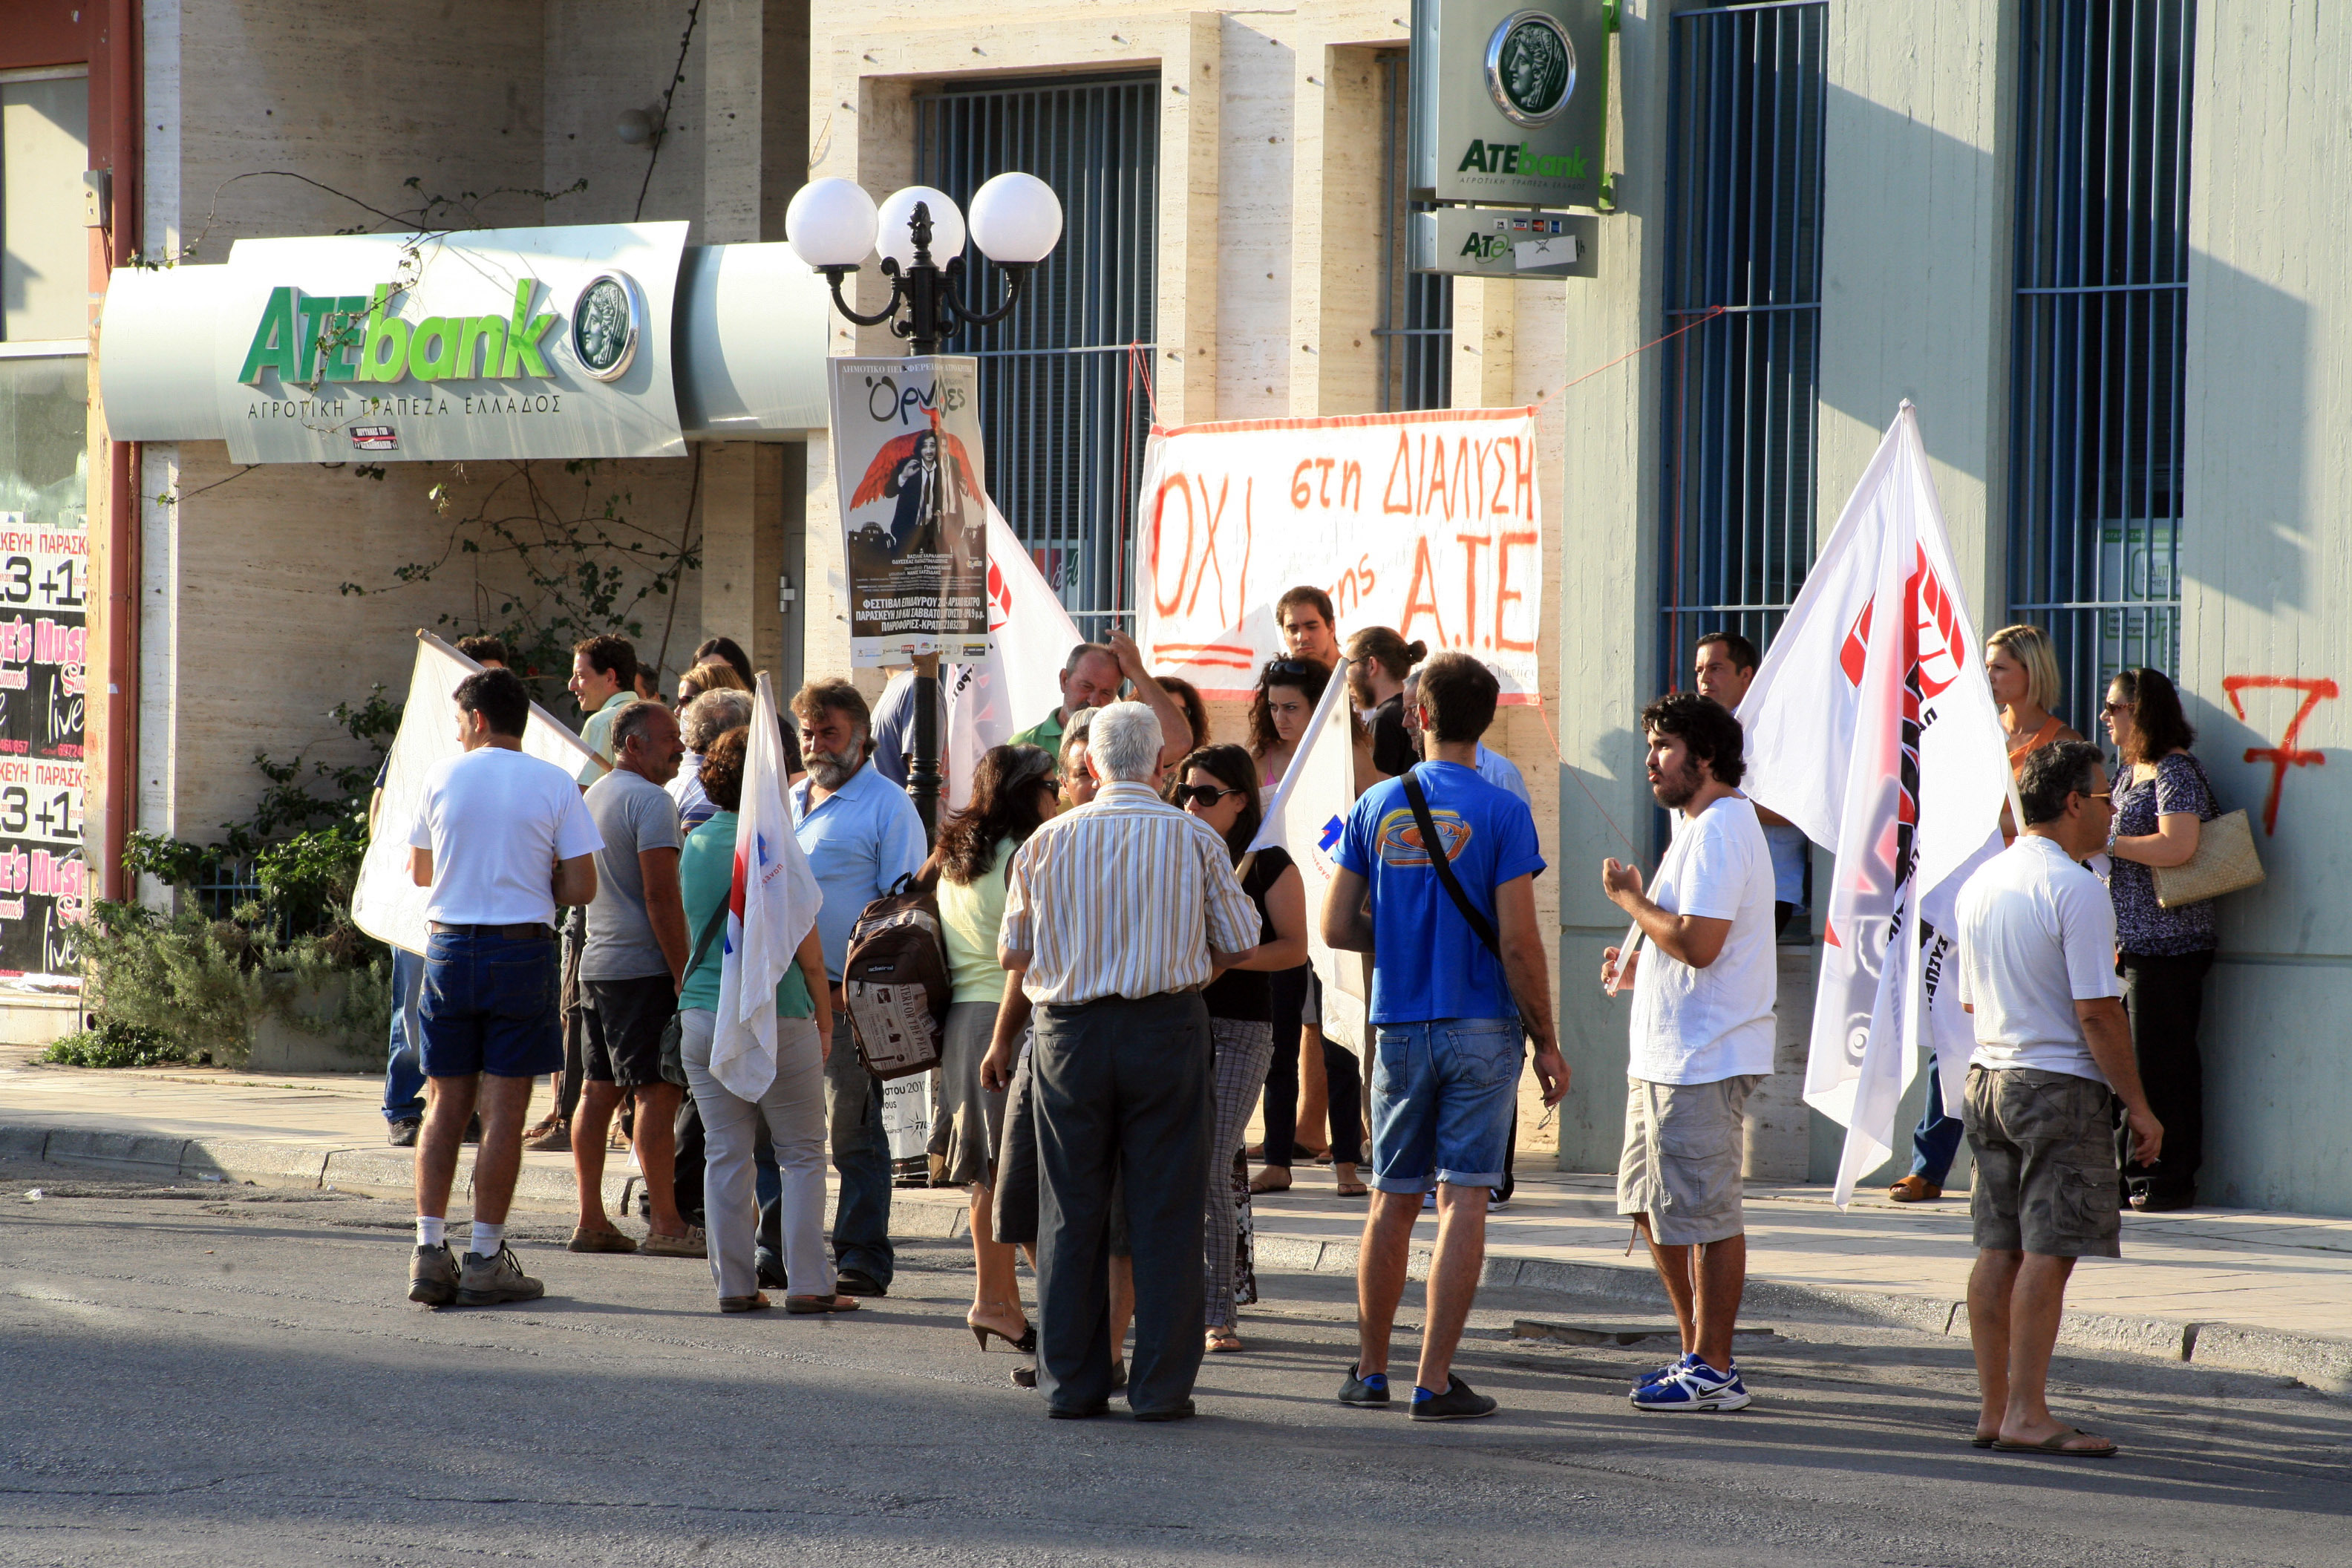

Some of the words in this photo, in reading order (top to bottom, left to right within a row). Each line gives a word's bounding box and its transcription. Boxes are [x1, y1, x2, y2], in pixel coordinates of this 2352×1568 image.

[1457, 139, 1590, 179] ATEbank
[1460, 177, 1506, 185] ΑΓΡΟΤΙΚΗ
[238, 277, 560, 385] ATEbank
[248, 400, 344, 419] ΑΓΡΟΤΙΚΗ
[359, 397, 449, 416] ΤΡΑΠΕΖΑ
[464, 394, 561, 414] ΕΛΛΑΔΟΣ
[1383, 429, 1535, 521] ΔΙΑΛΥΣΗ
[0, 532, 32, 552] ΚΕΥΗ
[1152, 472, 1253, 633] ΟΧΙ
[1324, 552, 1376, 618] ης
[855, 610, 895, 621] ΠΑΡΑΣΚΕΥΗ
[863, 598, 901, 609] ΦΕΣΤΙΒΑΛ
